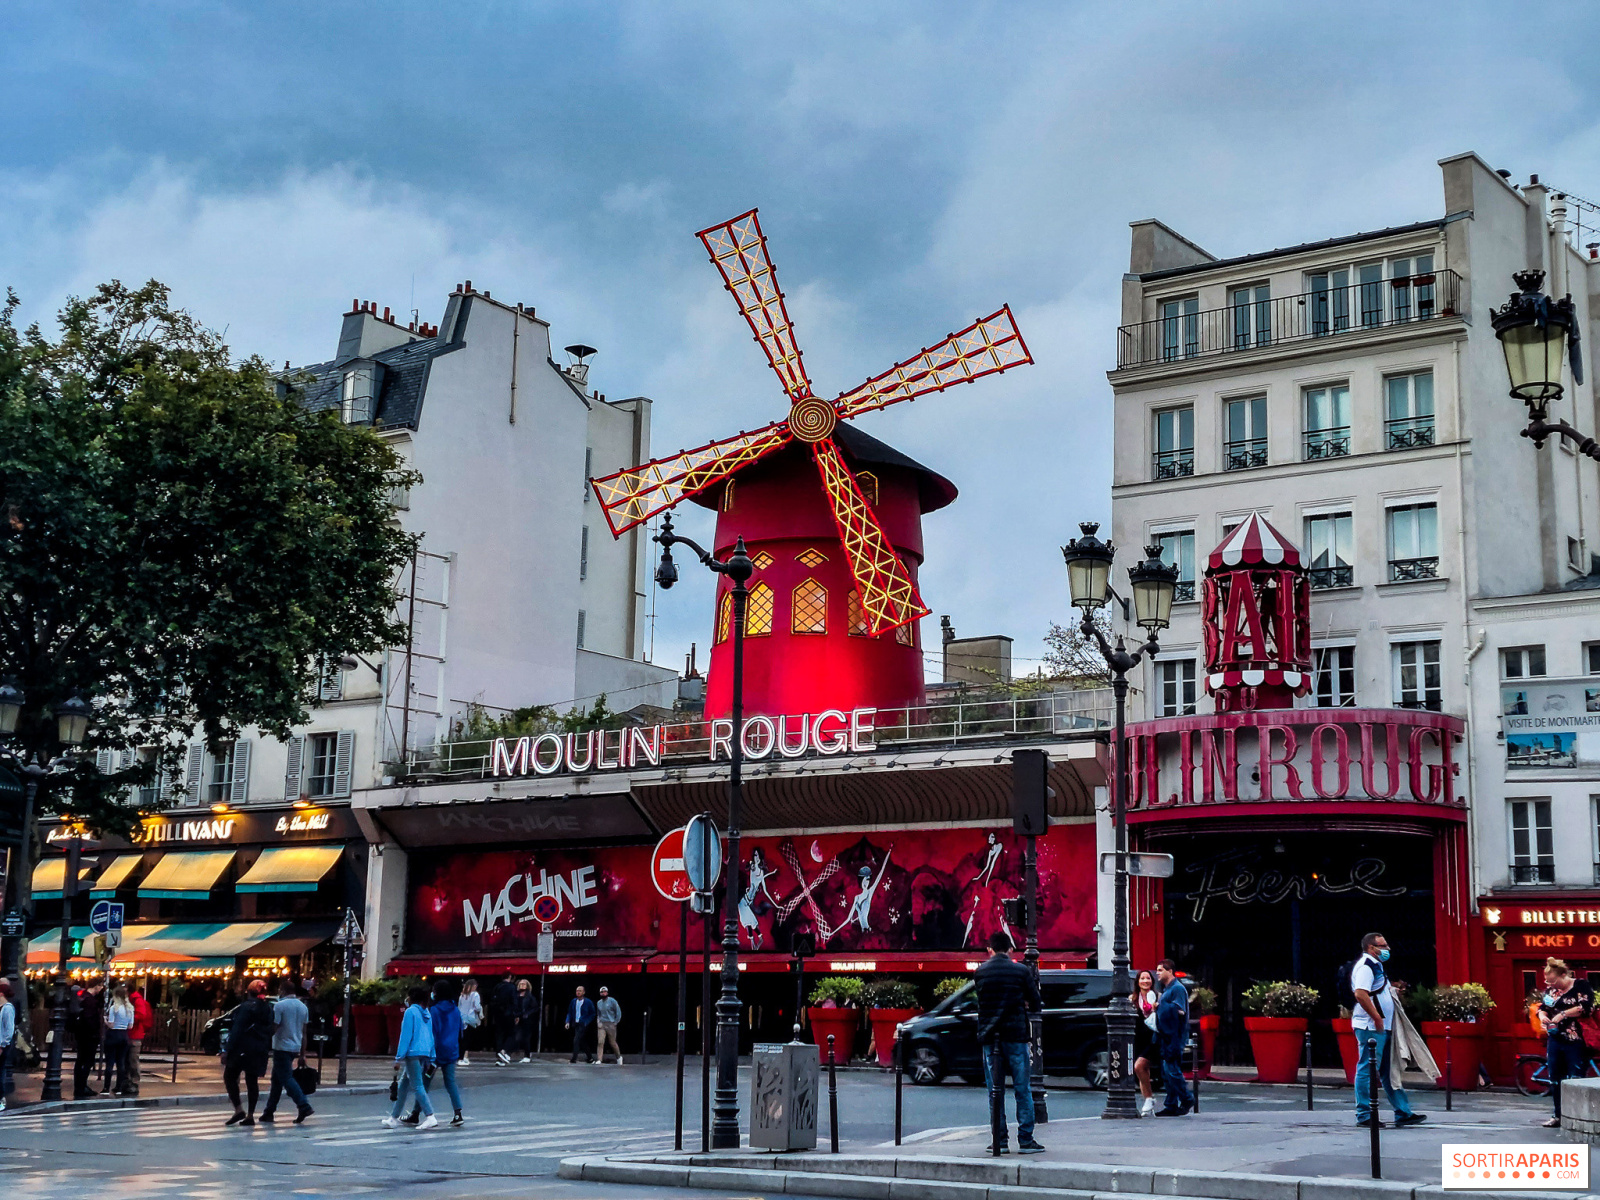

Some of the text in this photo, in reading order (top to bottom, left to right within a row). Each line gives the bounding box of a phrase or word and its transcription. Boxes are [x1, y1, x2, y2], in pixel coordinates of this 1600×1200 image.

[1214, 686, 1257, 711] DU
[1508, 718, 1532, 728] VISITE
[1535, 718, 1547, 727] DE
[493, 707, 877, 776] MOULIN ROUGE
[1258, 723, 1464, 808] ROUGE
[275, 815, 289, 835] By
[290, 815, 306, 830] the
[463, 865, 598, 937] MACHINE
[583, 929, 597, 937] CLUB
[1523, 935, 1600, 947] TICKET O
